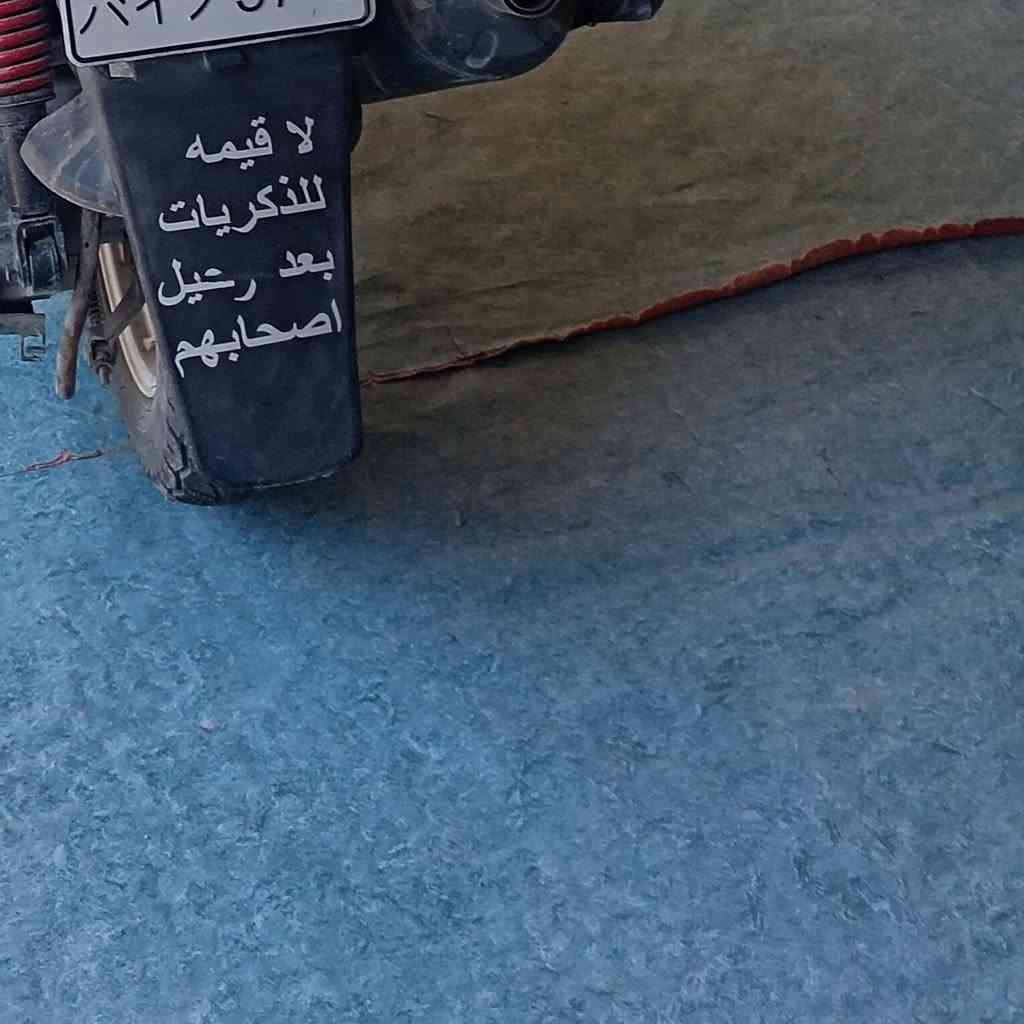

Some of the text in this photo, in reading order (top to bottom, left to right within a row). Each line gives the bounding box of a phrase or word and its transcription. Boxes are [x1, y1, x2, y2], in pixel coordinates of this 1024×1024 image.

[185, 116, 315, 170] لا قيمه
[158, 174, 327, 237] للذكريات
[279, 249, 335, 281] بعد
[175, 298, 342, 378] اصحابهم
